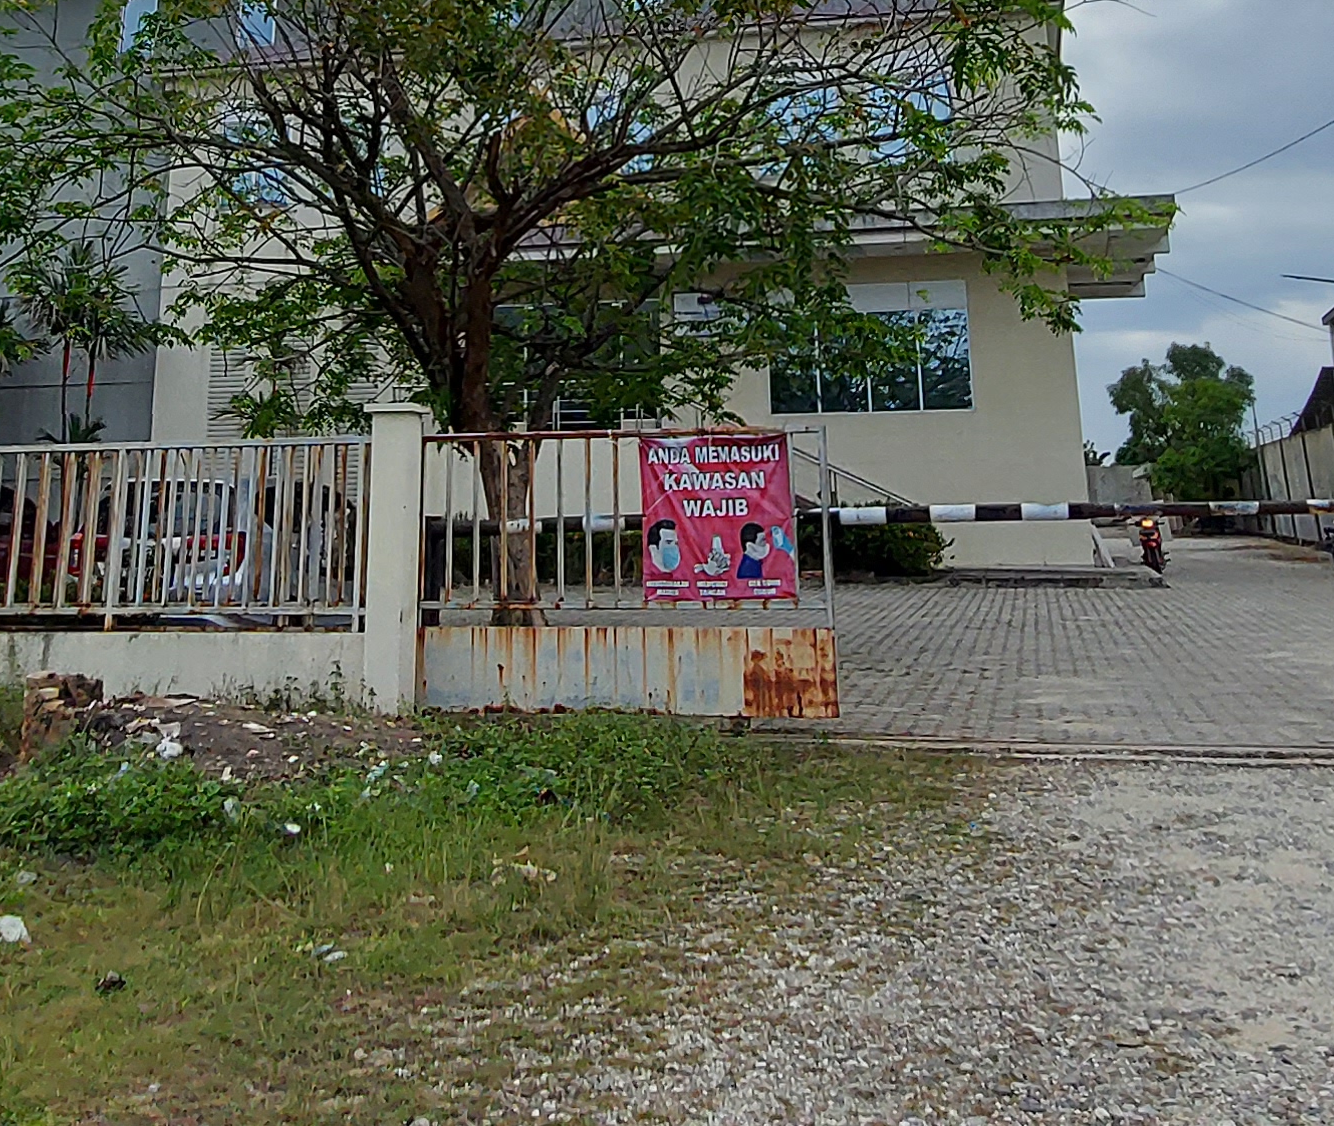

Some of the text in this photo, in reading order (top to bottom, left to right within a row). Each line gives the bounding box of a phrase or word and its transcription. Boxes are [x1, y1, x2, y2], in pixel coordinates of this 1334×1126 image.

[648, 444, 780, 464] ANDA MEMASUKI
[664, 471, 765, 491] KAWASAN
[683, 499, 749, 517] WAJIB
